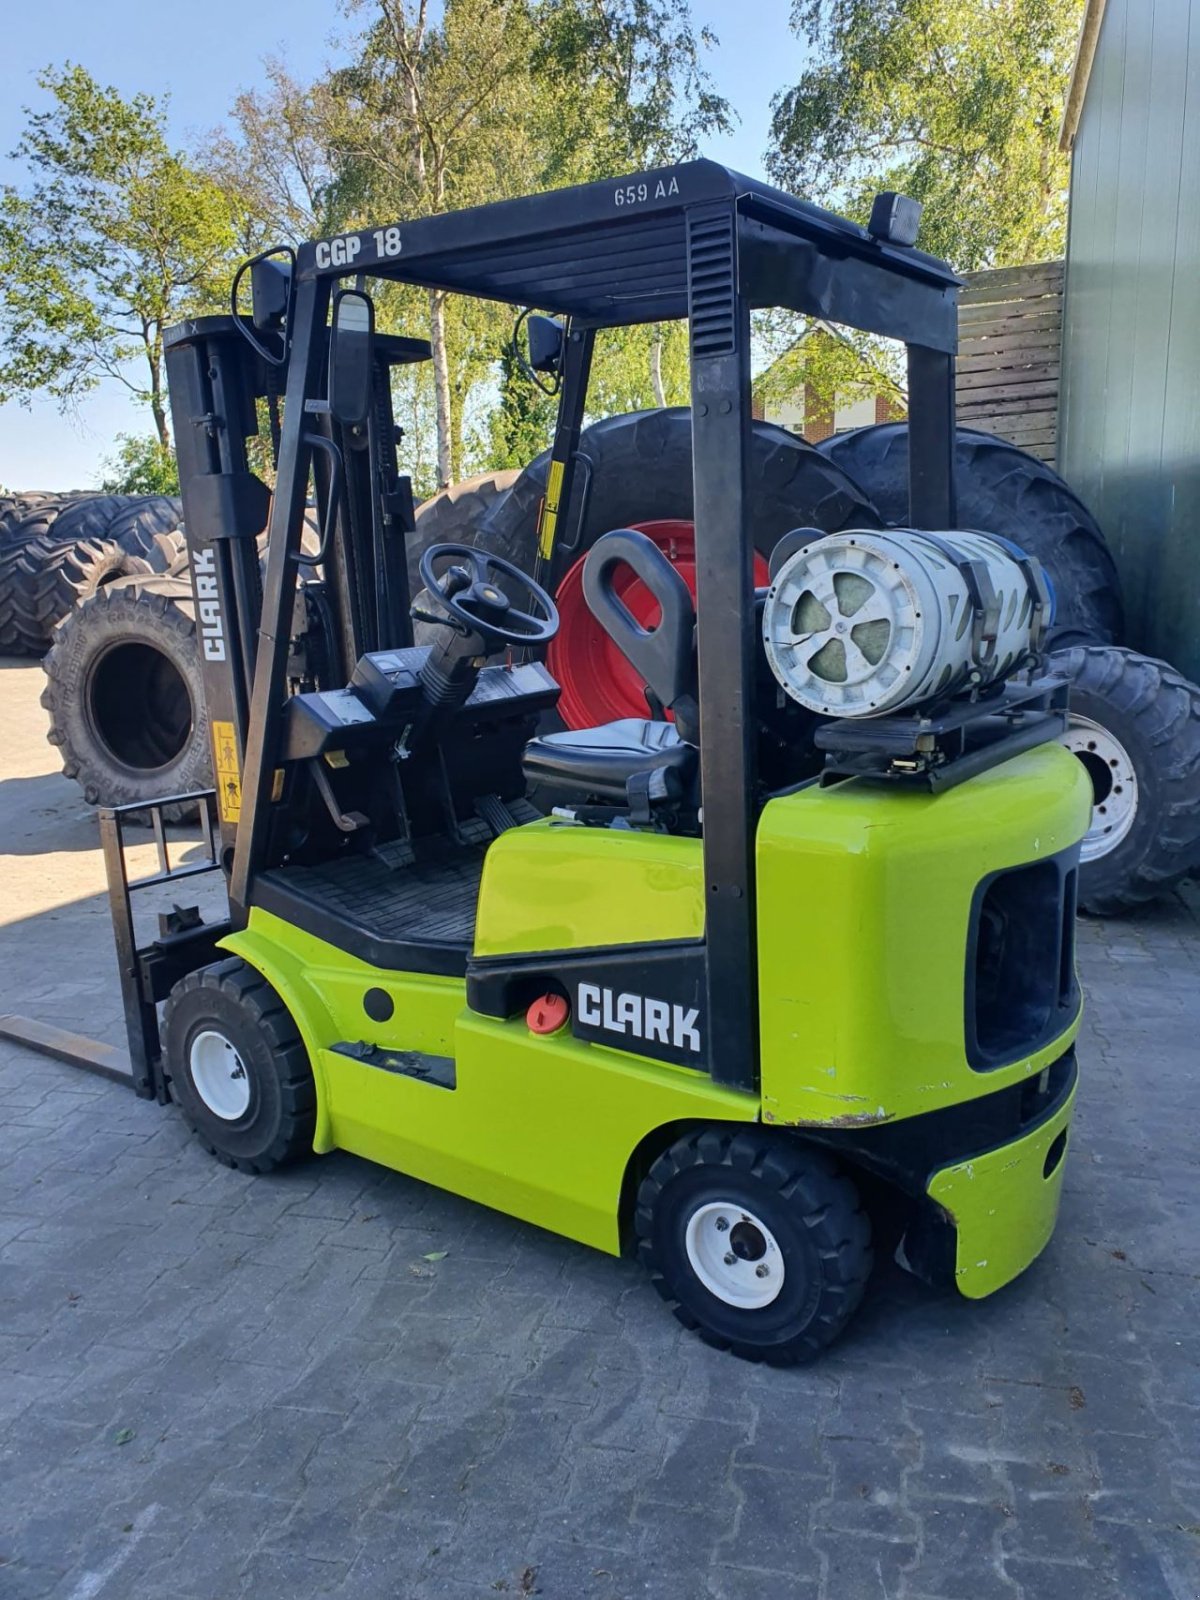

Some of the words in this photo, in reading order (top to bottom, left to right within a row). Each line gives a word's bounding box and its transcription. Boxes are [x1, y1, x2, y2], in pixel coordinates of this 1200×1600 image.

[614, 183, 648, 206] 659
[654, 176, 680, 199] AA
[315, 235, 361, 269] CGP
[372, 227, 402, 258] 18
[192, 548, 226, 661] CLARK
[578, 982, 701, 1053] CLARK
